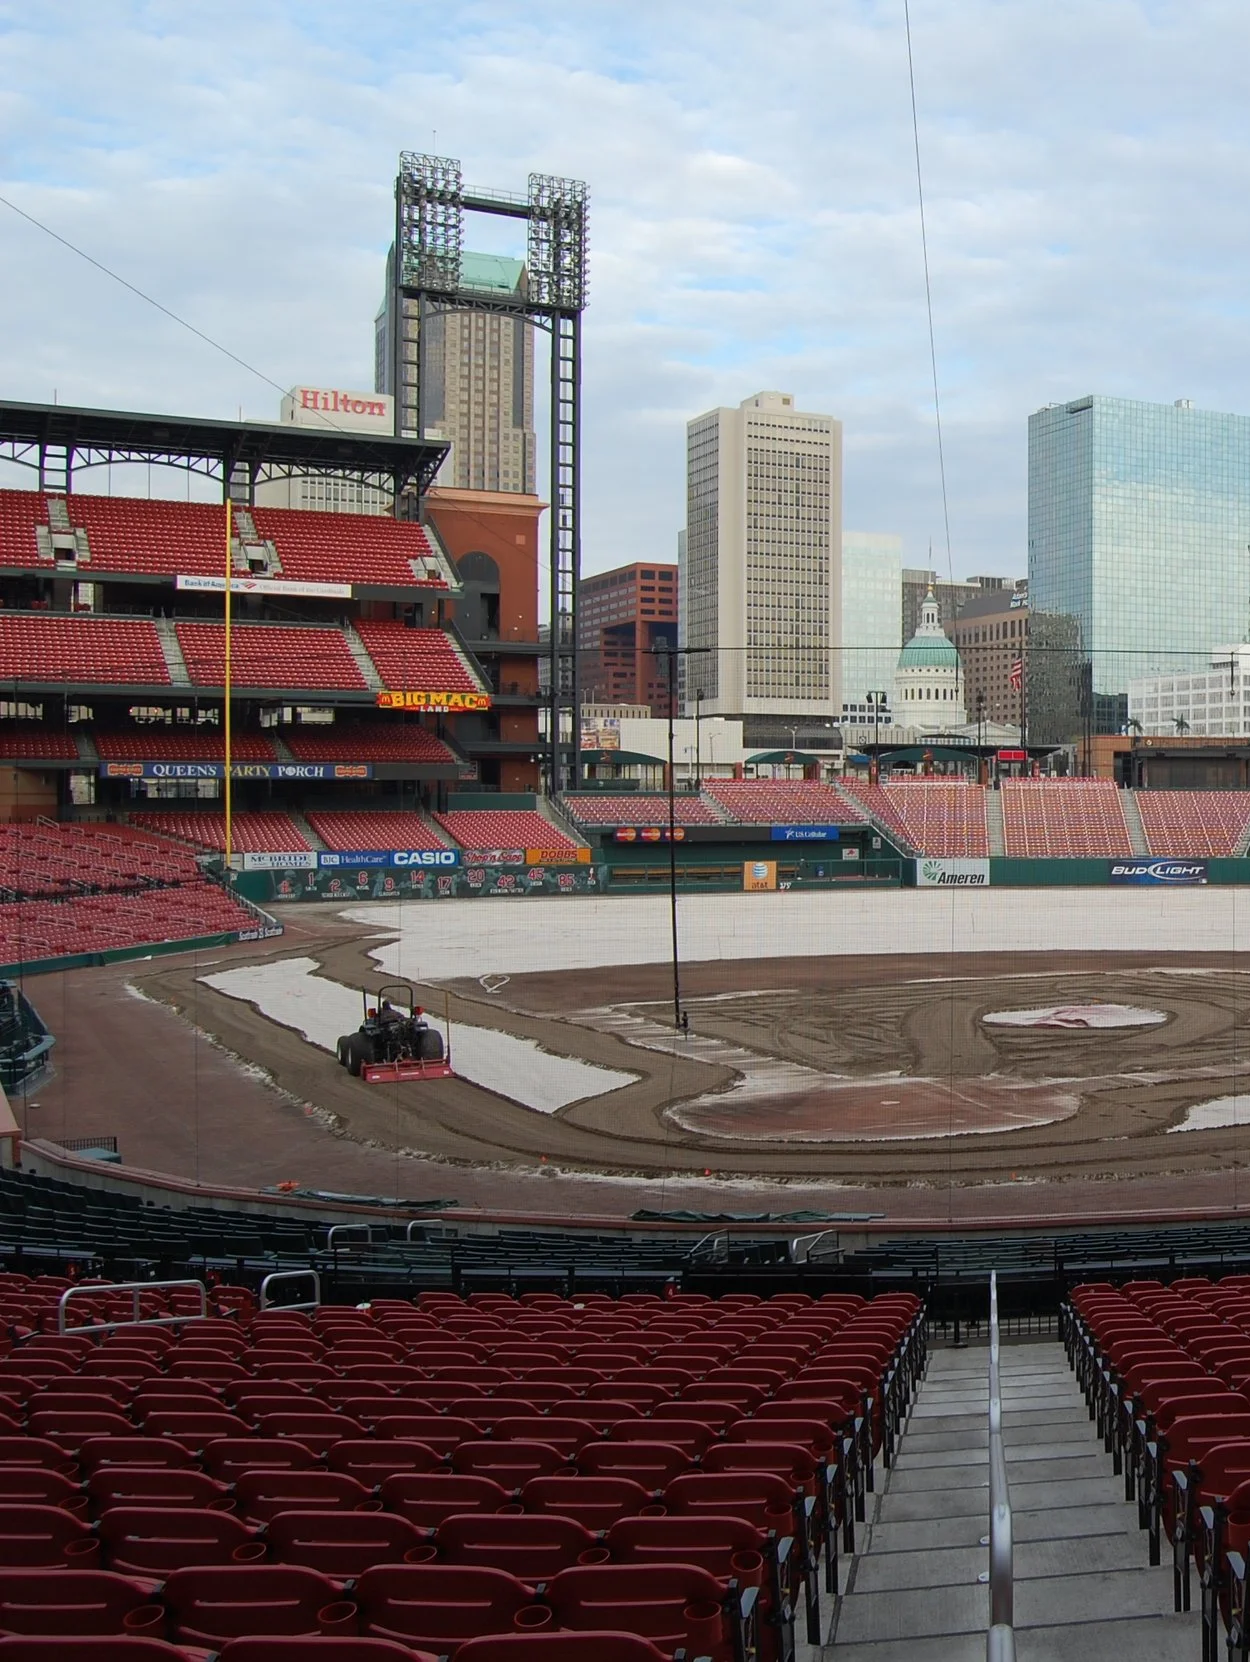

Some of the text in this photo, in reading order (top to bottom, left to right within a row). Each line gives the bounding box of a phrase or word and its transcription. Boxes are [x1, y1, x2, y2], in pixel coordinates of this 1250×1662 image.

[300, 389, 386, 416] Hilton
[391, 691, 477, 709] BIG MAC
[420, 705, 449, 713] LAND
[323, 855, 384, 864] BJC HealthCare
[393, 852, 455, 865] CASIO
[541, 850, 578, 859] DOBBS
[410, 870, 424, 884] 14
[467, 869, 485, 883] 20
[527, 867, 545, 880] 45
[1111, 866, 1205, 875] BUD LIGHT
[308, 872, 314, 886] 1
[358, 871, 368, 886] 6
[384, 877, 395, 892] 9
[437, 876, 452, 889] 17
[497, 874, 516, 888] 42
[557, 873, 576, 887] 85
[937, 871, 985, 885] Ameren
[328, 879, 341, 893] 2
